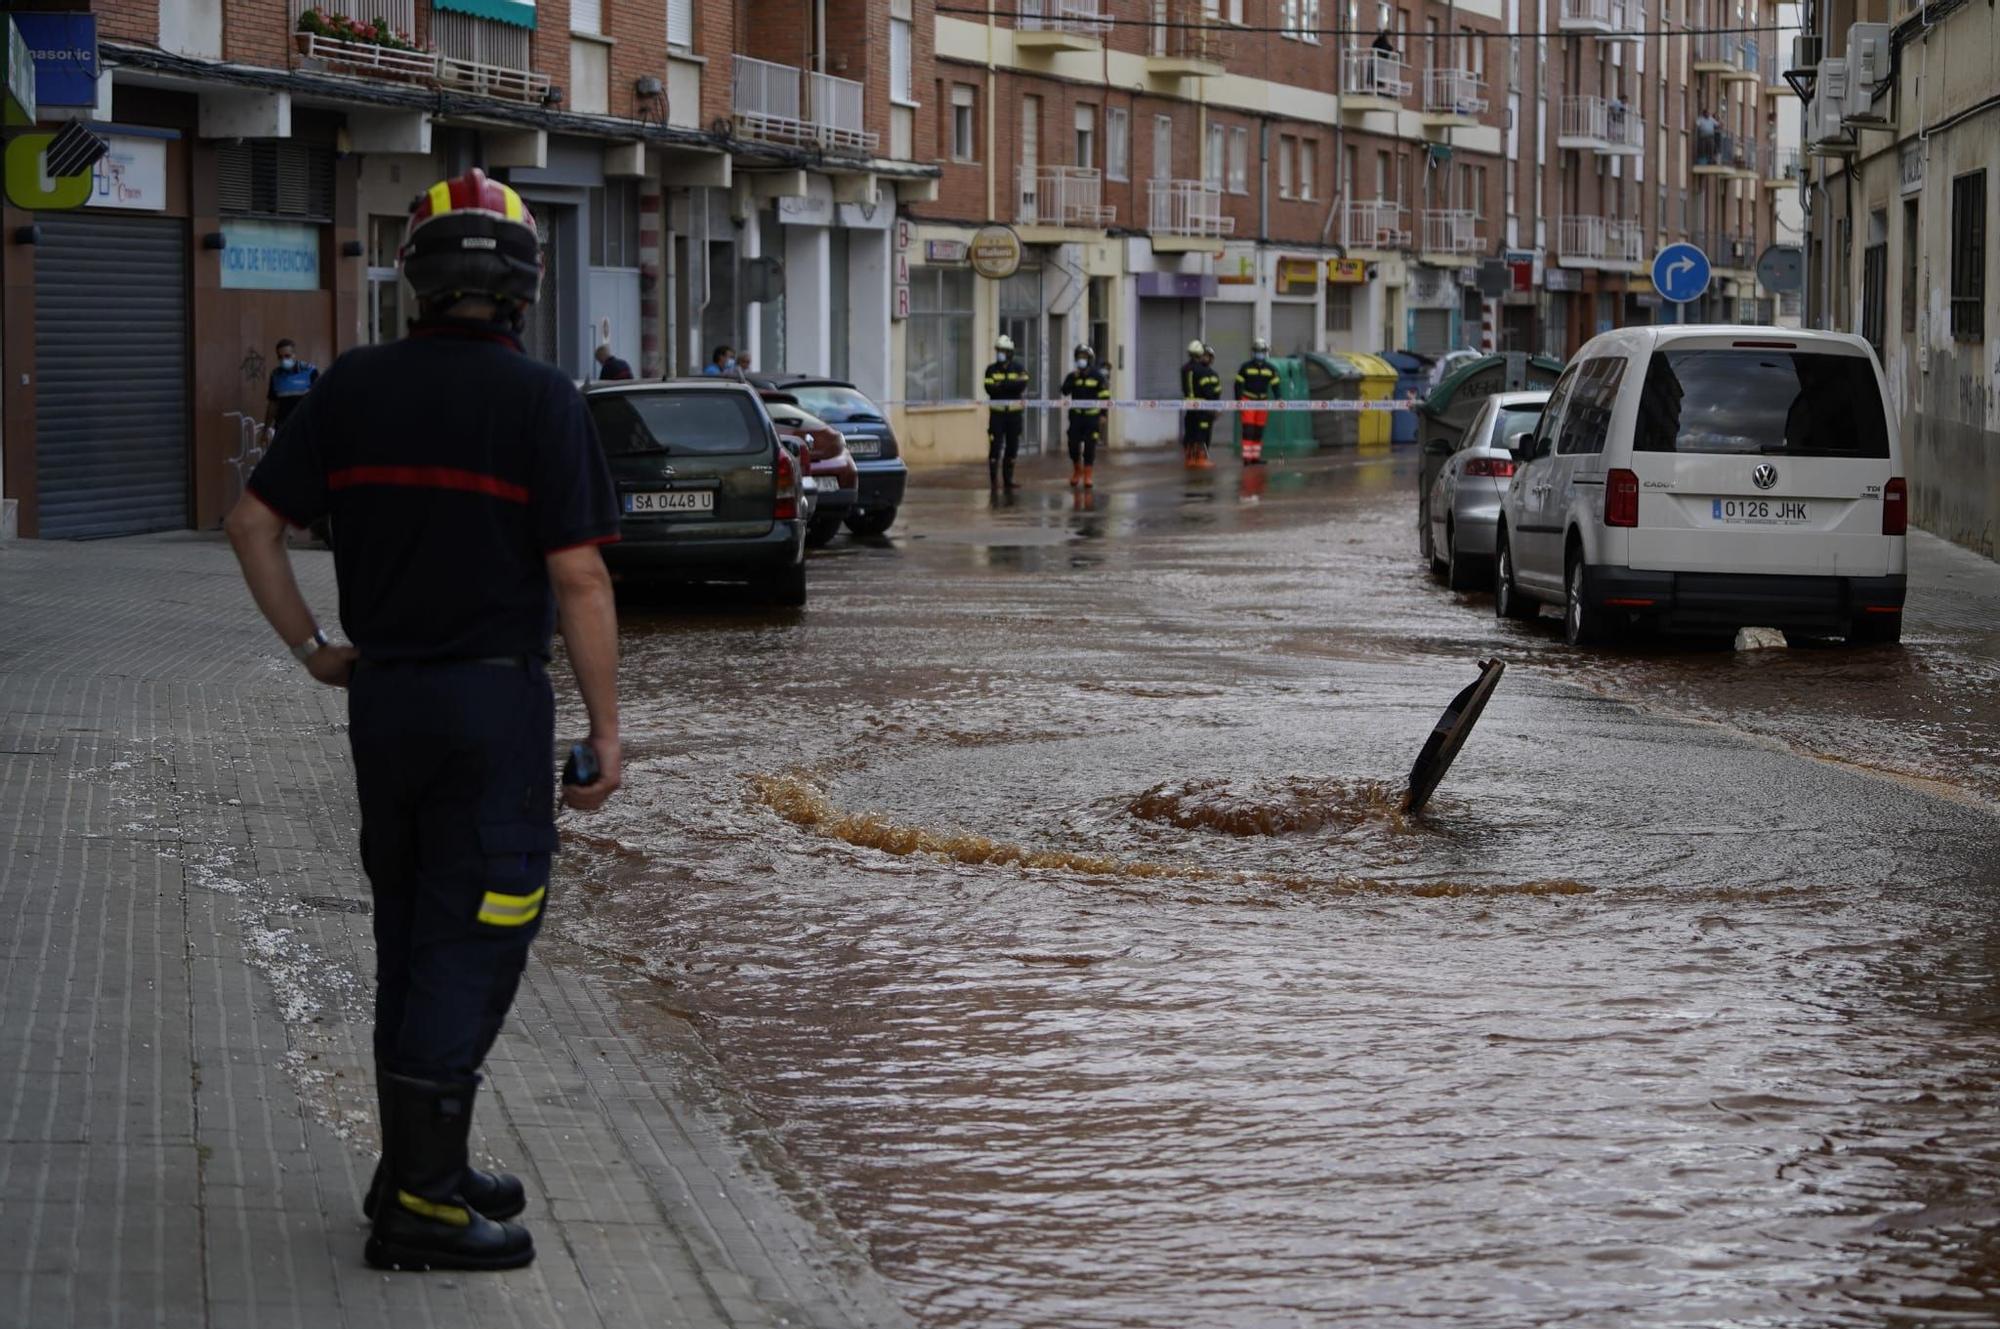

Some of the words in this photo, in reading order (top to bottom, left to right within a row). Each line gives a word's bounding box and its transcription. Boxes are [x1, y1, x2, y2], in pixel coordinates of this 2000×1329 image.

[900, 223, 909, 315] BAR
[635, 494, 654, 510] SA
[658, 493, 697, 509] 0448
[701, 492, 712, 508] U
[1725, 500, 1769, 519] 0126
[1775, 502, 1807, 520] JHK
